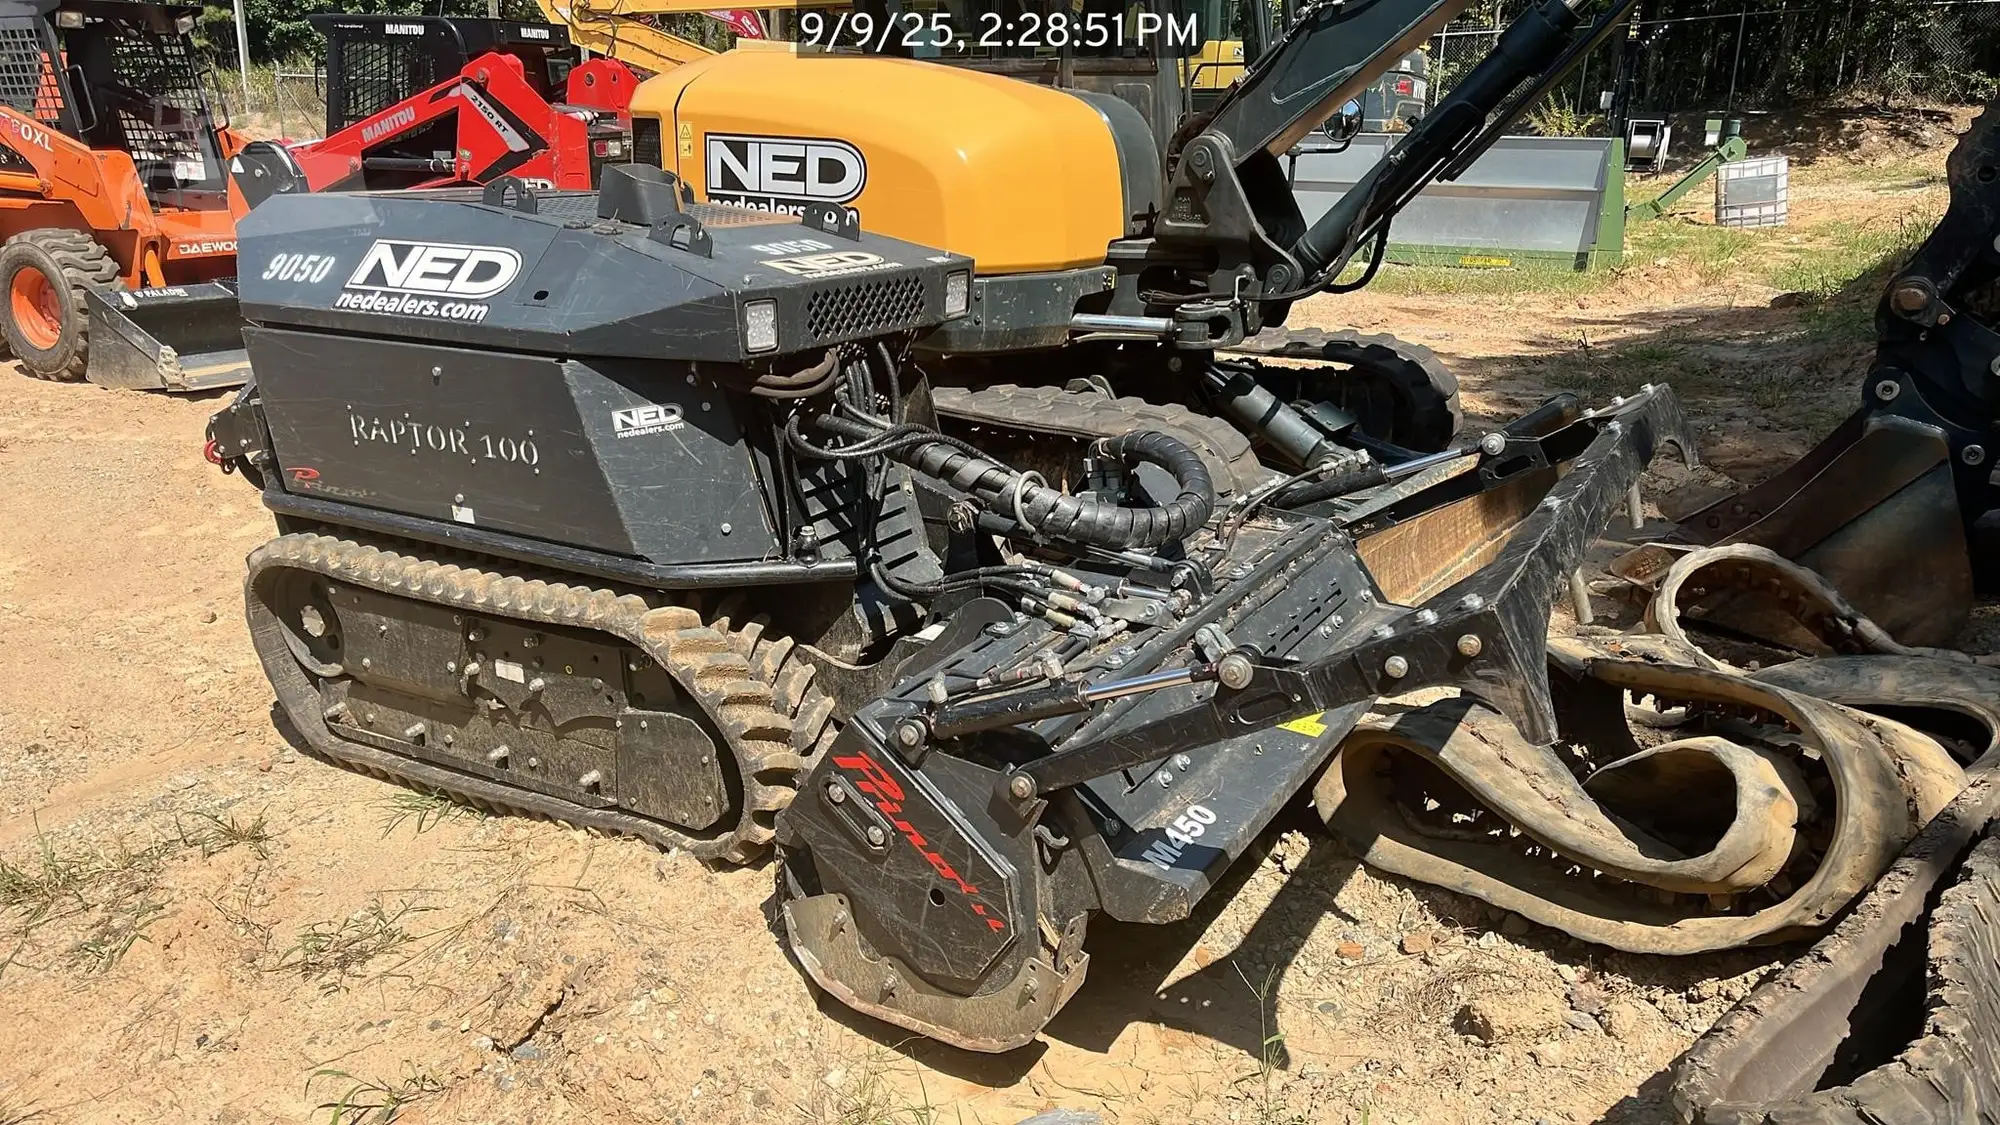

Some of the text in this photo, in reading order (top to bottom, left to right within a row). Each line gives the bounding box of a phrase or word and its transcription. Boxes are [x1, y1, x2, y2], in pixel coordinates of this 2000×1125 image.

[385, 24, 425, 35] MANITOU
[520, 28, 550, 39] MANITOU
[361, 105, 416, 143] MANITOU
[470, 94, 510, 134] 2150 RT
[709, 139, 862, 197] NED
[261, 253, 336, 284] 9050
[350, 242, 519, 294] NED
[762, 251, 883, 275] NED
[335, 291, 490, 324] nedealers.com
[613, 403, 684, 431] NED
[616, 422, 685, 439] nedealers.com
[349, 414, 540, 466] RAPTOR 100
[1141, 804, 1217, 871] M450
